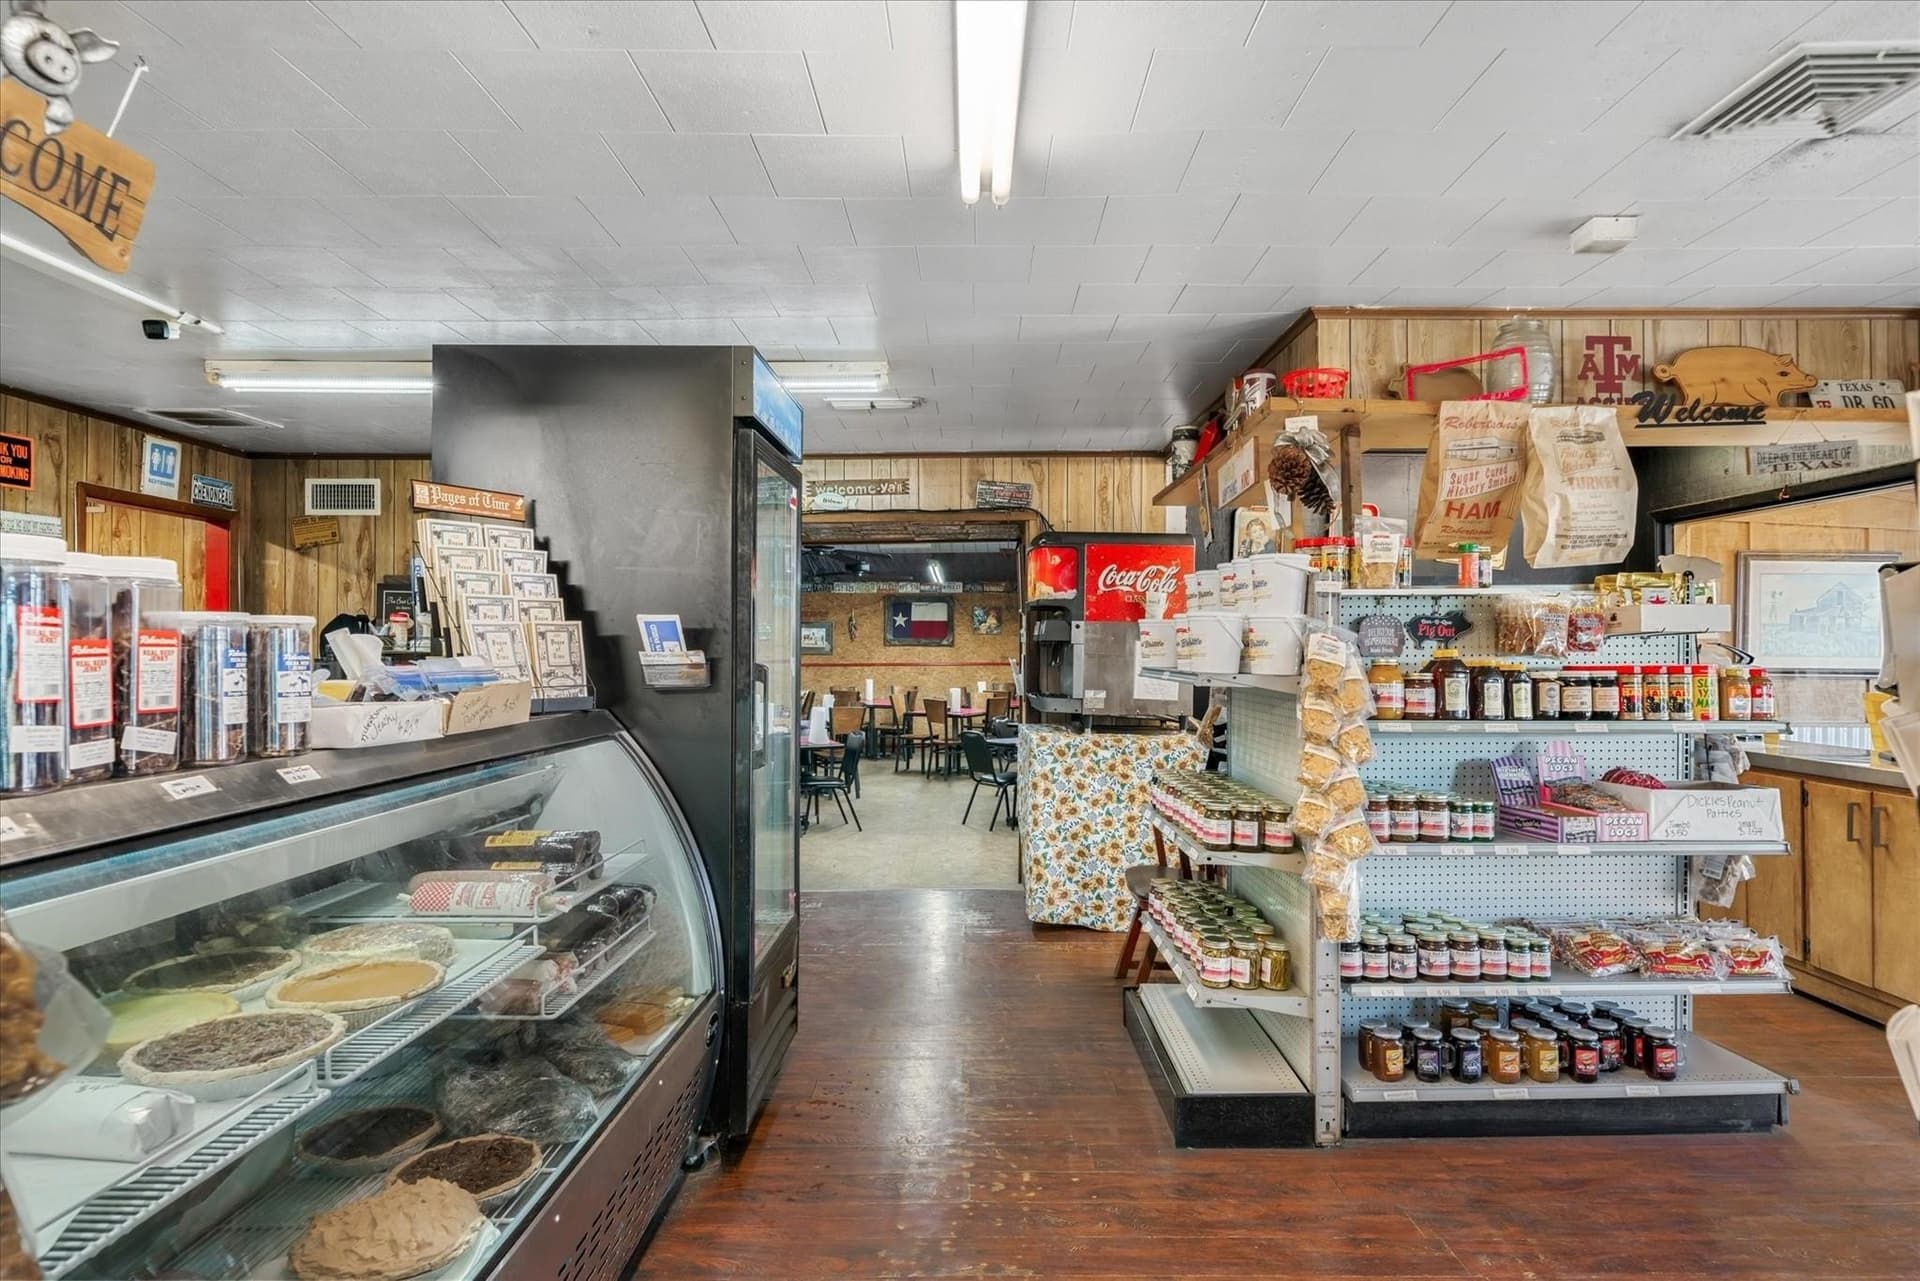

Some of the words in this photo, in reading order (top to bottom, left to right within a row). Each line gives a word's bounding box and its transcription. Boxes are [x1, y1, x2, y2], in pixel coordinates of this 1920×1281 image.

[1838, 383, 1874, 393] TEXAS
[1632, 390, 1766, 424] Welcome
[1809, 448, 1839, 461] HEART
[1840, 446, 1853, 460] OF
[1770, 460, 1843, 473] TEXAS
[1449, 471, 1480, 486] Sugar
[429, 483, 466, 506] Pages
[468, 492, 481, 507] of
[482, 492, 510, 511] Time
[1444, 500, 1502, 519] HAM
[1098, 563, 1181, 594] Coca-Cola
[1417, 623, 1436, 639] Pig
[1437, 625, 1456, 637] Out
[1544, 757, 1578, 765] PECAN
[1605, 816, 1642, 826] PECAN
